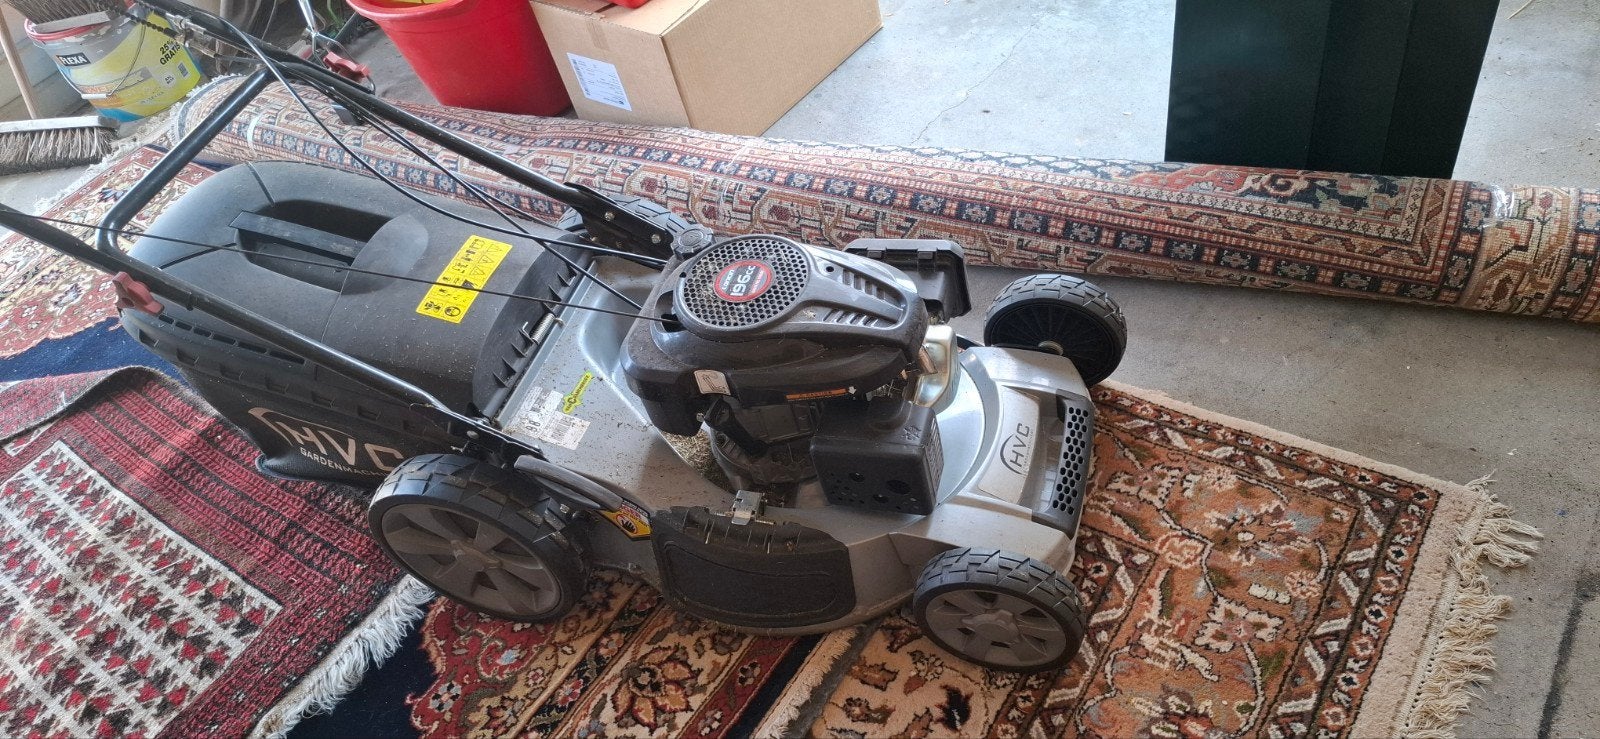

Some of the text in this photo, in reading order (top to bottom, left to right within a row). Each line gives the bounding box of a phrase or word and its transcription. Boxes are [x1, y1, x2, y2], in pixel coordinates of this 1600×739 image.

[58, 55, 88, 65] FLEXA
[160, 43, 180, 65] GRATIS
[730, 265, 756, 296] 196cc
[276, 421, 404, 472] HVC
[1010, 422, 1030, 468] HVC
